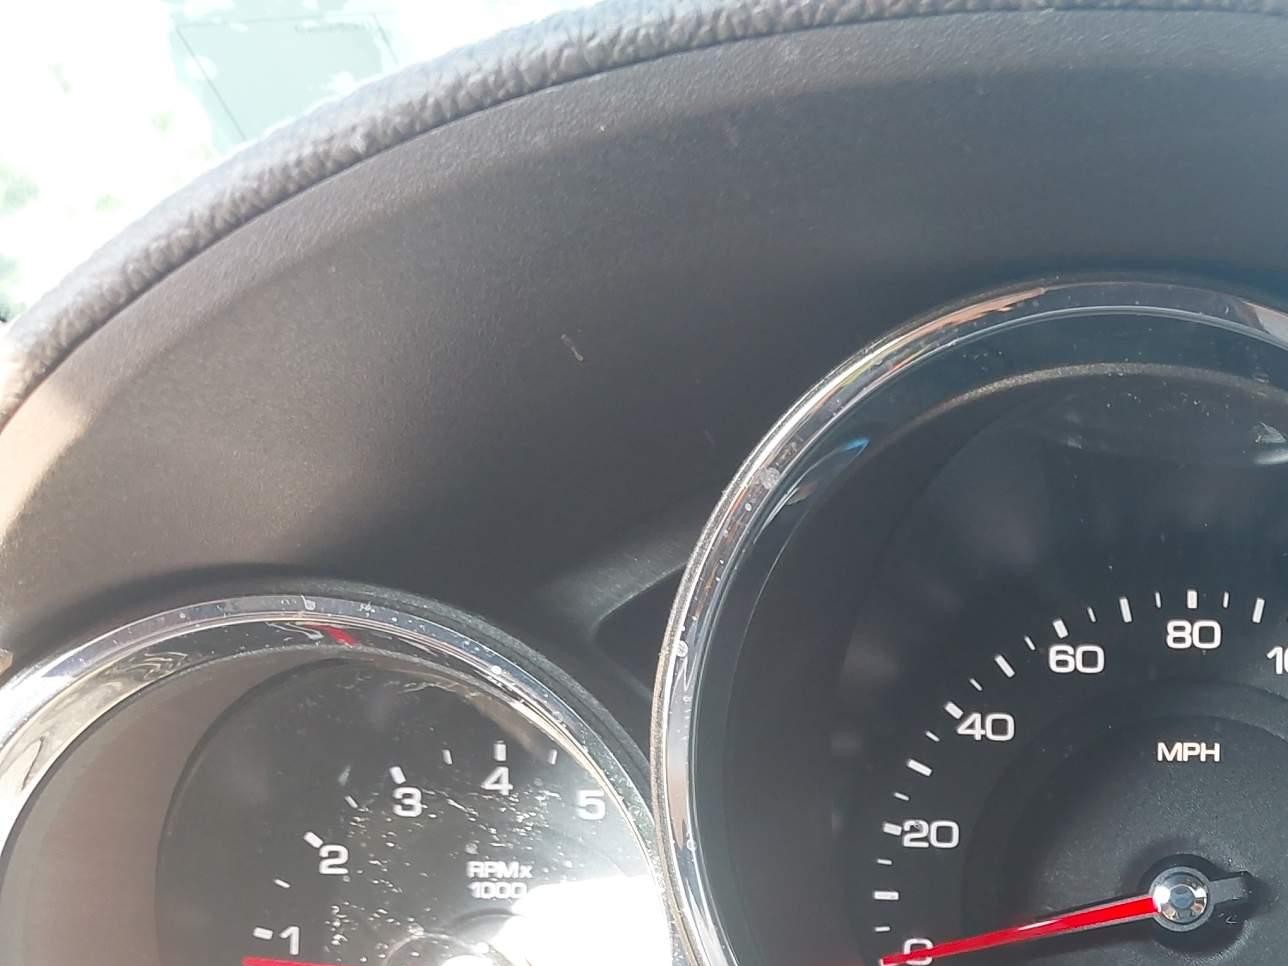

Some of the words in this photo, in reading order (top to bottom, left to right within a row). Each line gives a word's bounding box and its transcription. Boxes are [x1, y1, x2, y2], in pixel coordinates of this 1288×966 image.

[1166, 619, 1222, 650] 80
[1048, 644, 1105, 674] 60
[956, 712, 1015, 742] 40
[1157, 742, 1221, 762] MPH
[480, 766, 513, 796] 4
[392, 786, 423, 818] 3
[576, 788, 607, 822] 5
[902, 819, 960, 849] 20
[318, 844, 349, 876] 2
[467, 880, 529, 900] 1000
[279, 926, 300, 955] 1
[903, 938, 934, 966] 0
